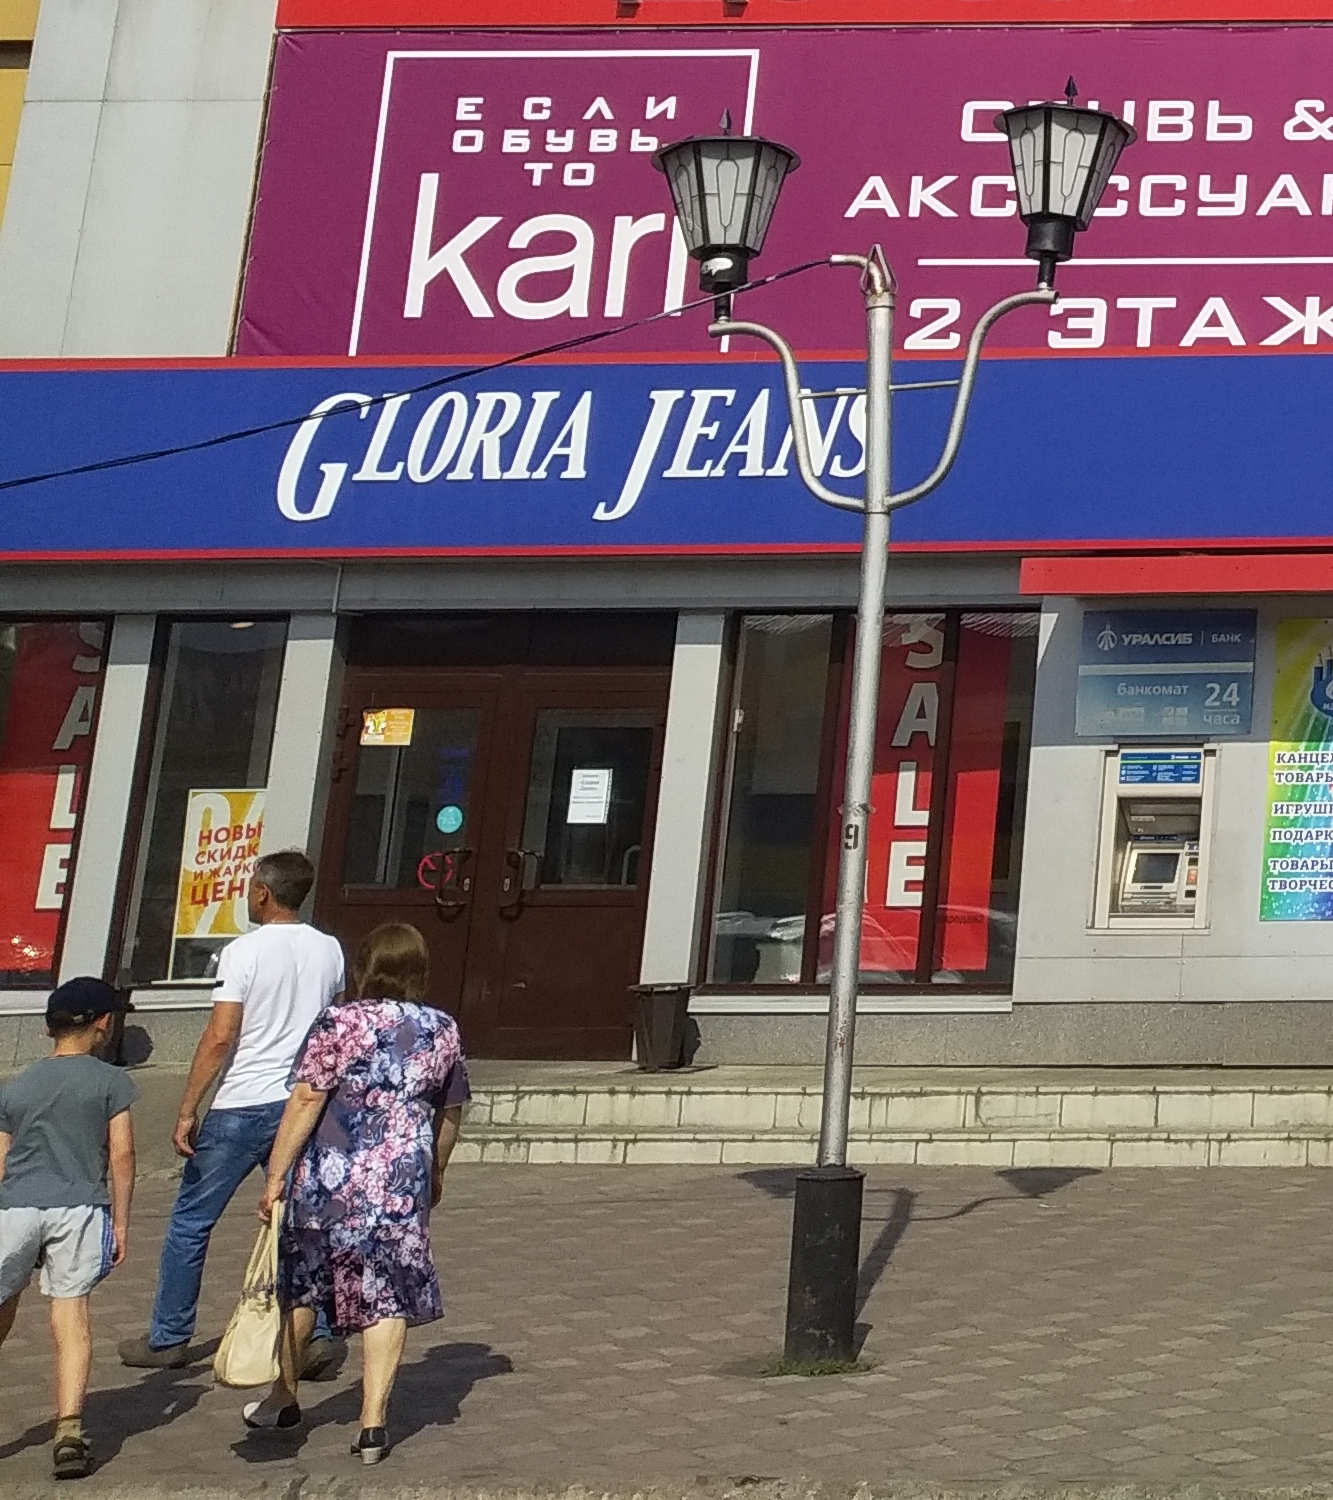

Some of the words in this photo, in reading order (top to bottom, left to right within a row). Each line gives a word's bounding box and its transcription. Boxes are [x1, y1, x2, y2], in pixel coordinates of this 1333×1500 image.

[455, 96, 677, 121] ЕСЛИ
[961, 99, 1252, 142] ОВЬ
[452, 128, 669, 153] ОБУВЬ
[524, 162, 595, 187] ТО
[403, 172, 689, 320] kari
[904, 299, 961, 350] 2
[276, 390, 594, 522] GLORIA
[592, 388, 871, 521] JEANS
[1121, 632, 1193, 645] УРАЛСИБ
[1211, 633, 1241, 643] БАНК
[1116, 682, 1189, 695] банкомат
[1204, 683, 1240, 706] 24
[1202, 713, 1241, 725] часа
[198, 821, 264, 846] НОВЫ
[844, 823, 860, 850] 9
[195, 843, 260, 865] СКИДК
[209, 862, 257, 880] ЖАРК
[190, 878, 245, 907] ЦЕН
